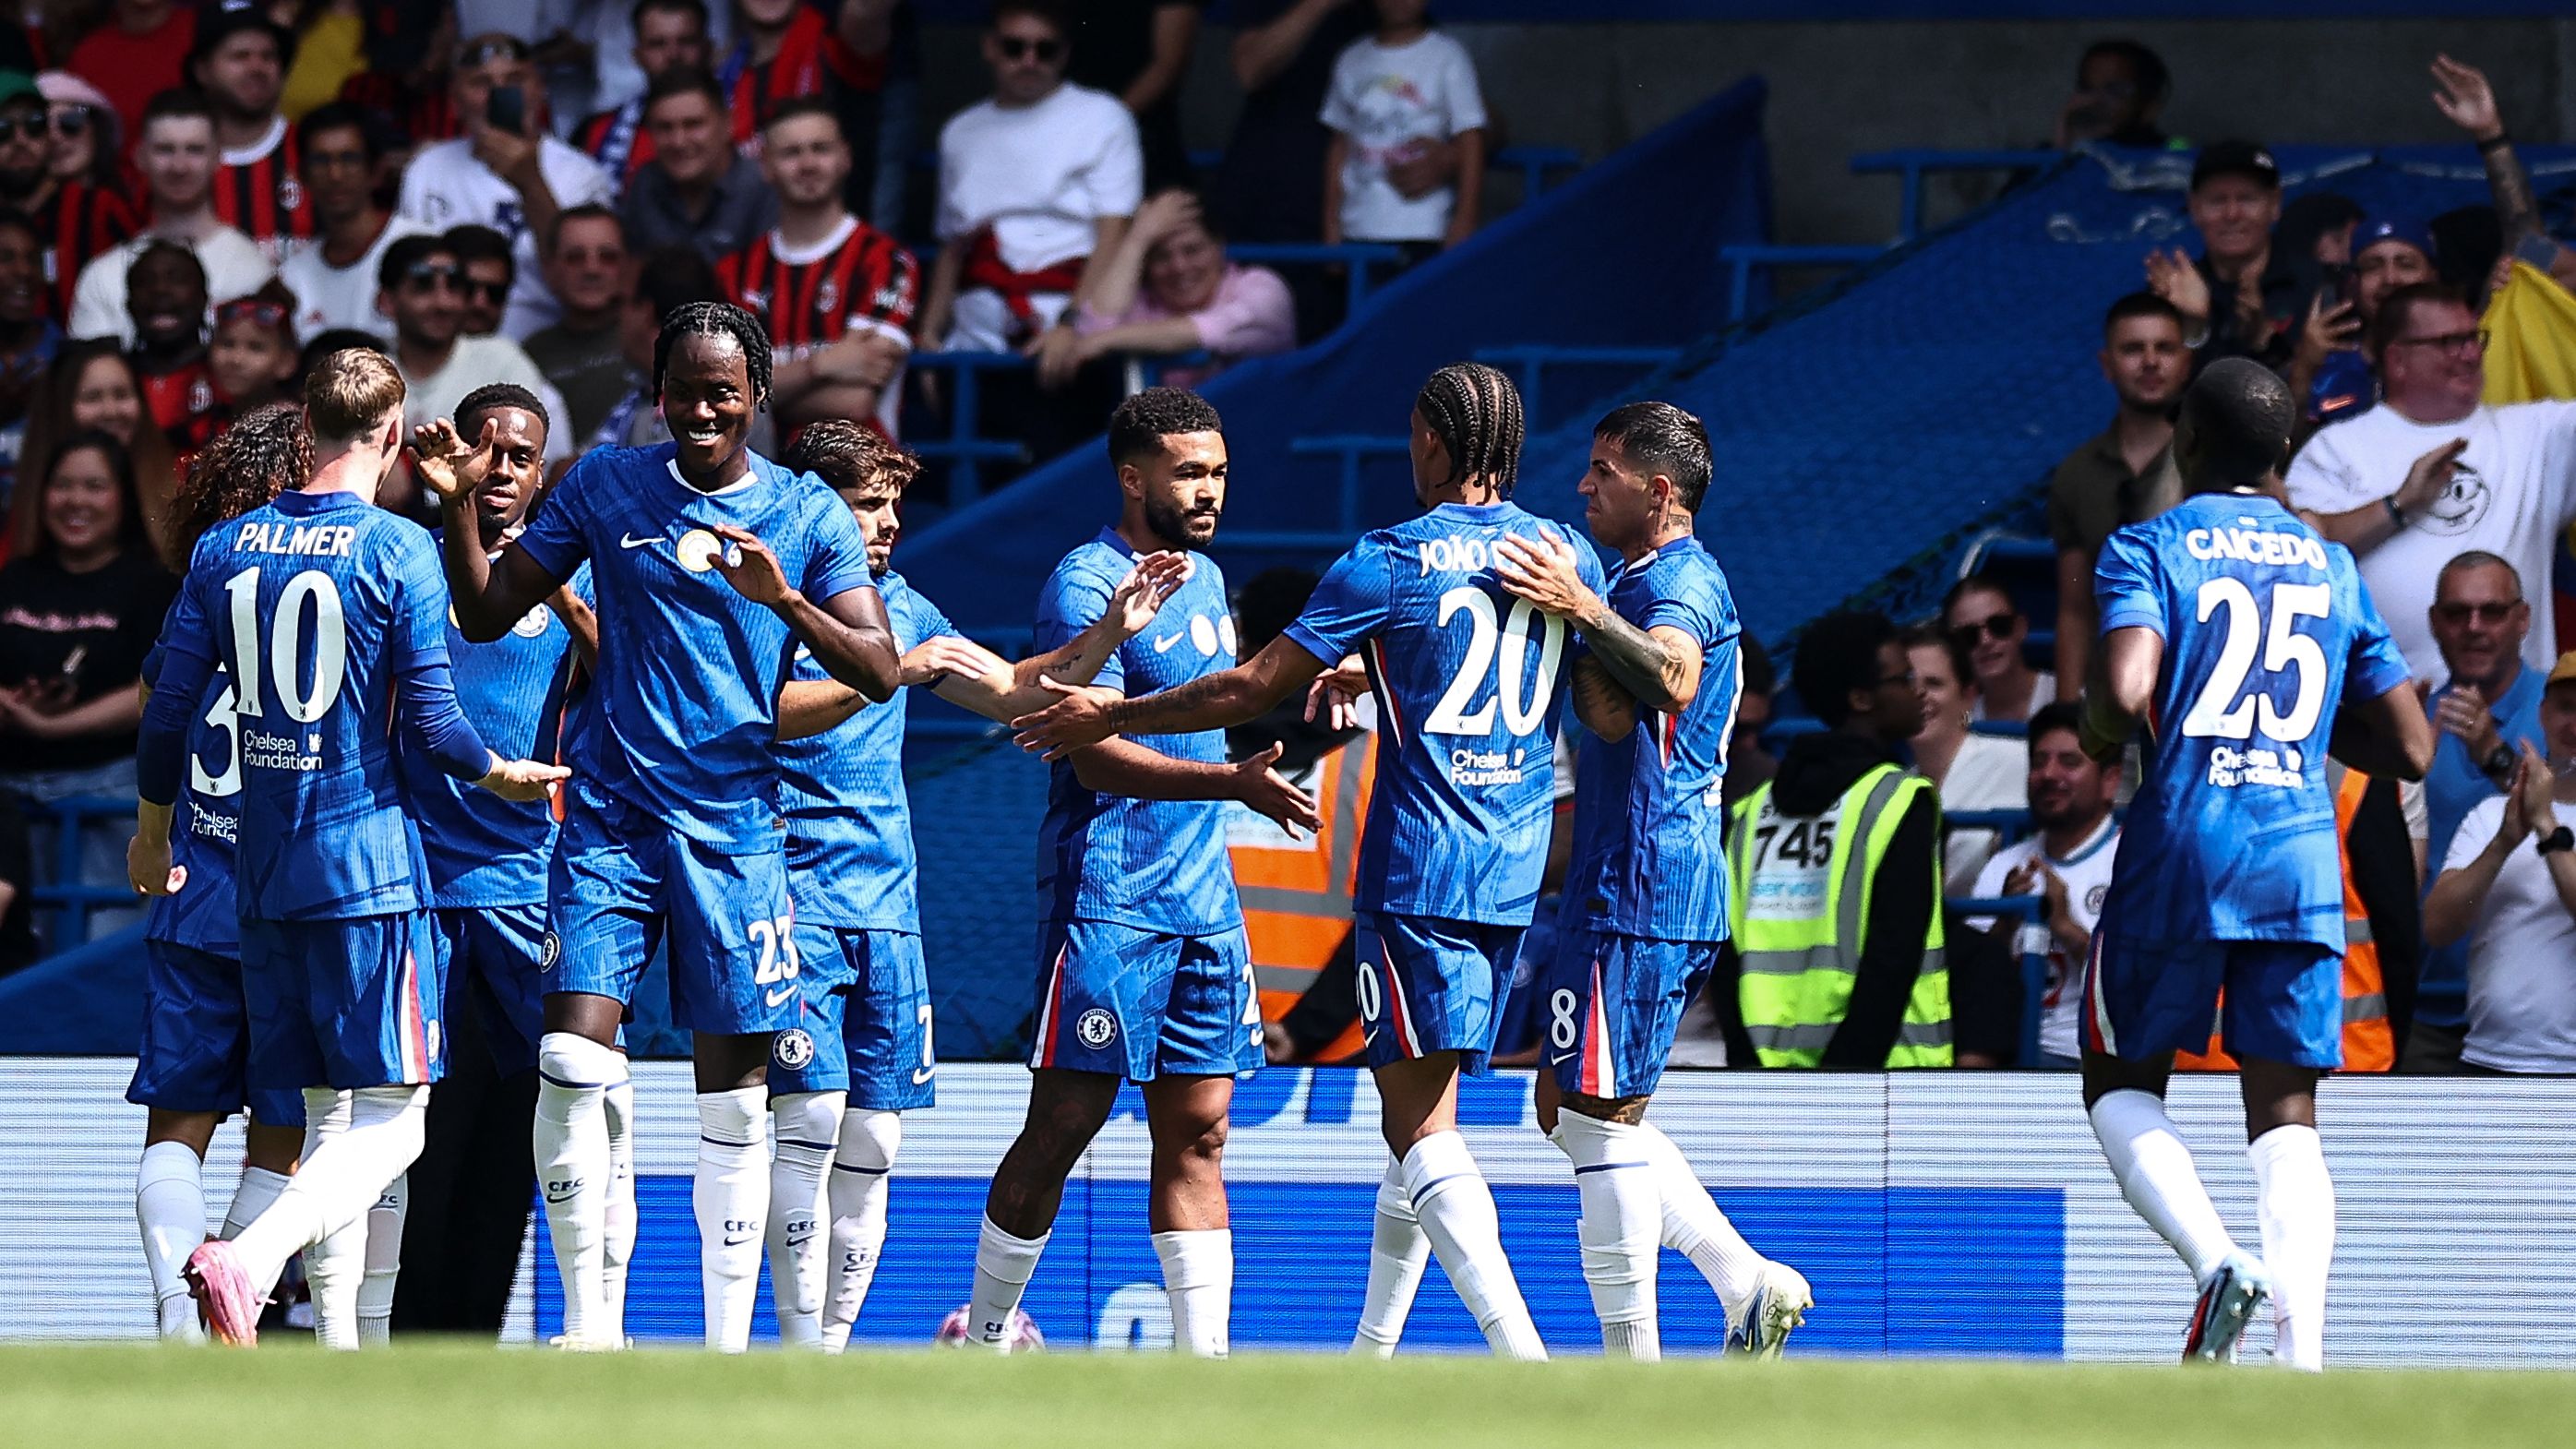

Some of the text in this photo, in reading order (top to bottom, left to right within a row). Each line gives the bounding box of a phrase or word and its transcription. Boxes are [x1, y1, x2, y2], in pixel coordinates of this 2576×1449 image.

[234, 522, 356, 557] PALMER
[1419, 534, 1488, 578] JOÃO
[2186, 527, 2328, 571] CAICEDO
[224, 566, 346, 724] 10
[1423, 585, 1565, 737] 20
[2182, 576, 2331, 743] 25
[190, 661, 243, 797] 3
[244, 728, 296, 753] Chelsea
[244, 747, 323, 772] Foundation
[1755, 820, 1837, 872] 745
[748, 915, 799, 985] 23
[1356, 961, 1381, 1024] 0
[917, 1003, 934, 1068] 7
[1551, 988, 1577, 1050] 8
[378, 1194, 399, 1204] FC
[547, 1177, 585, 1192] CFC
[724, 1219, 759, 1232] CFC
[786, 1220, 821, 1234] CFC
